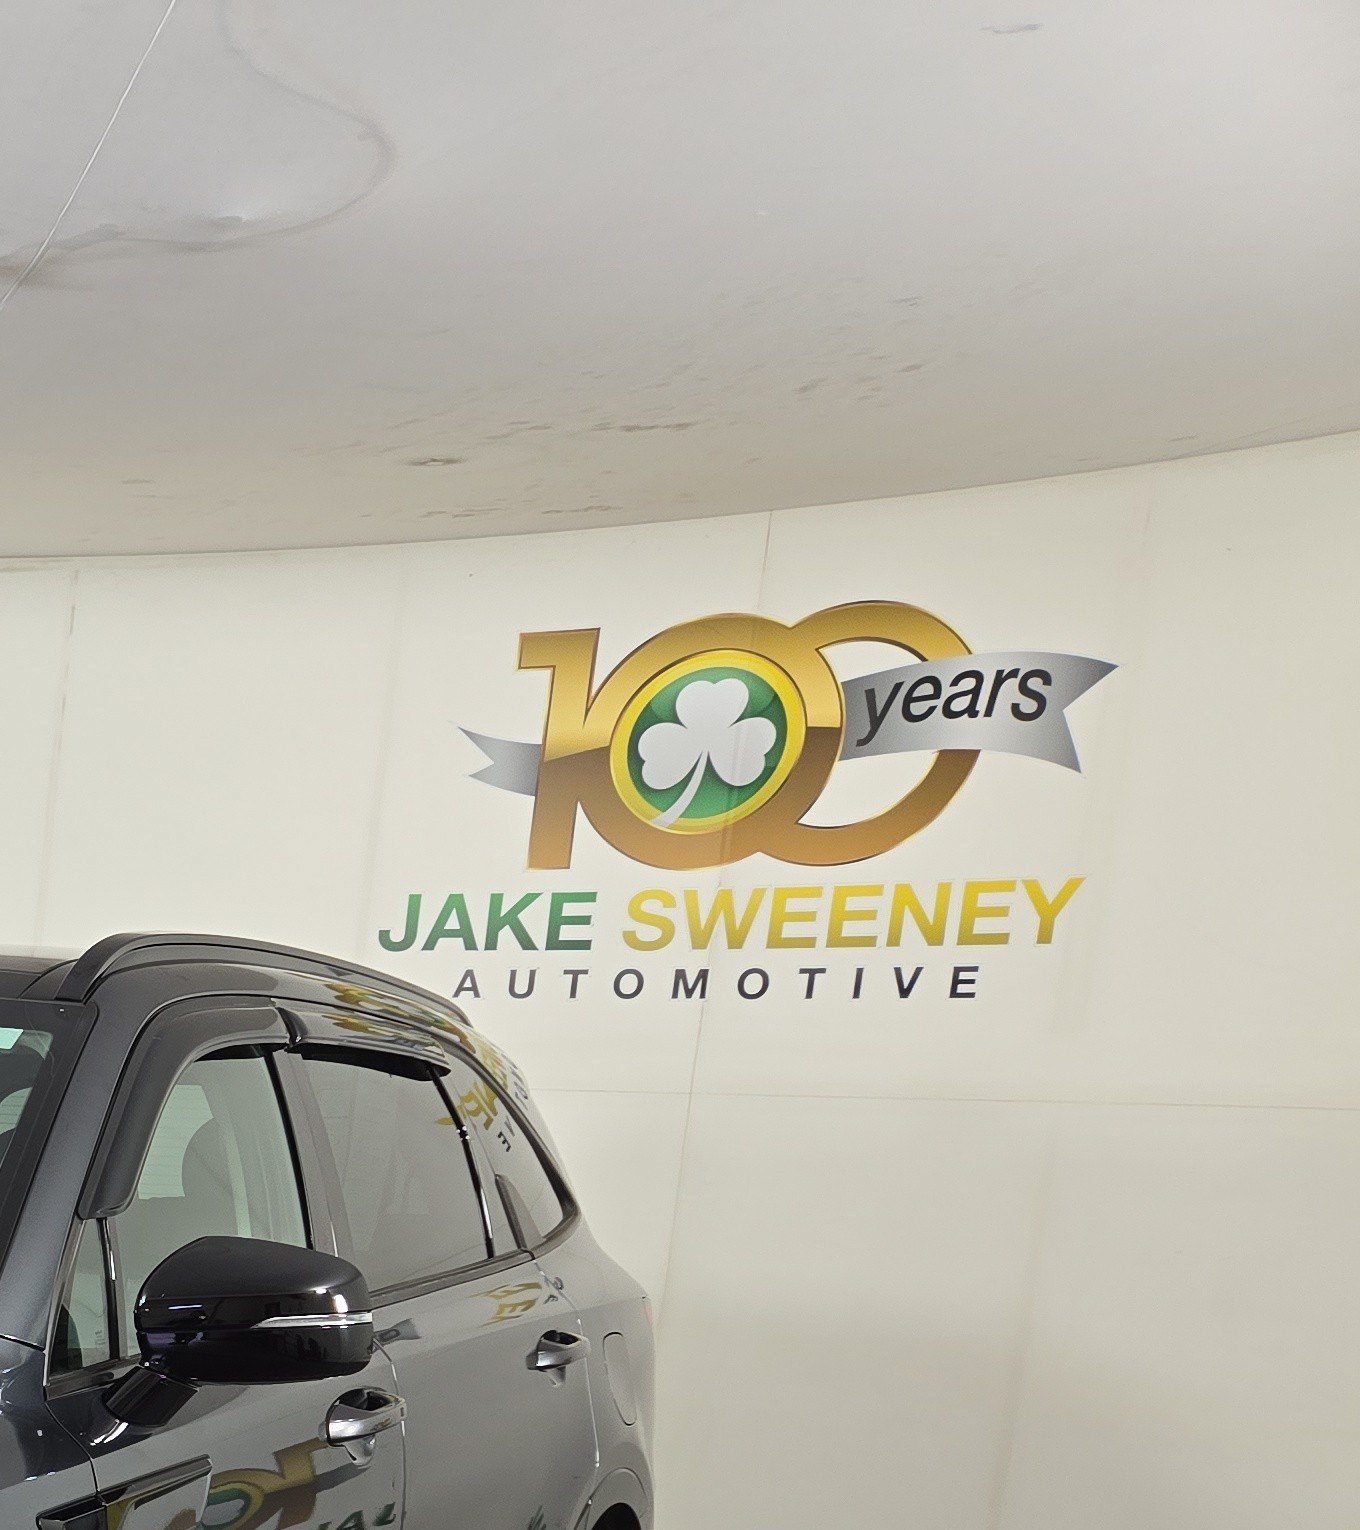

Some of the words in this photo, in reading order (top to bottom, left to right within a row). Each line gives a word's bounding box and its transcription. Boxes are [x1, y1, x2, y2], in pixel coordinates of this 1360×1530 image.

[516, 600, 982, 871] 100
[855, 667, 1052, 748] years
[378, 890, 598, 952] JAKE
[621, 876, 1086, 952] SWEENEY
[453, 965, 980, 1000] AUTOMOTIVE
